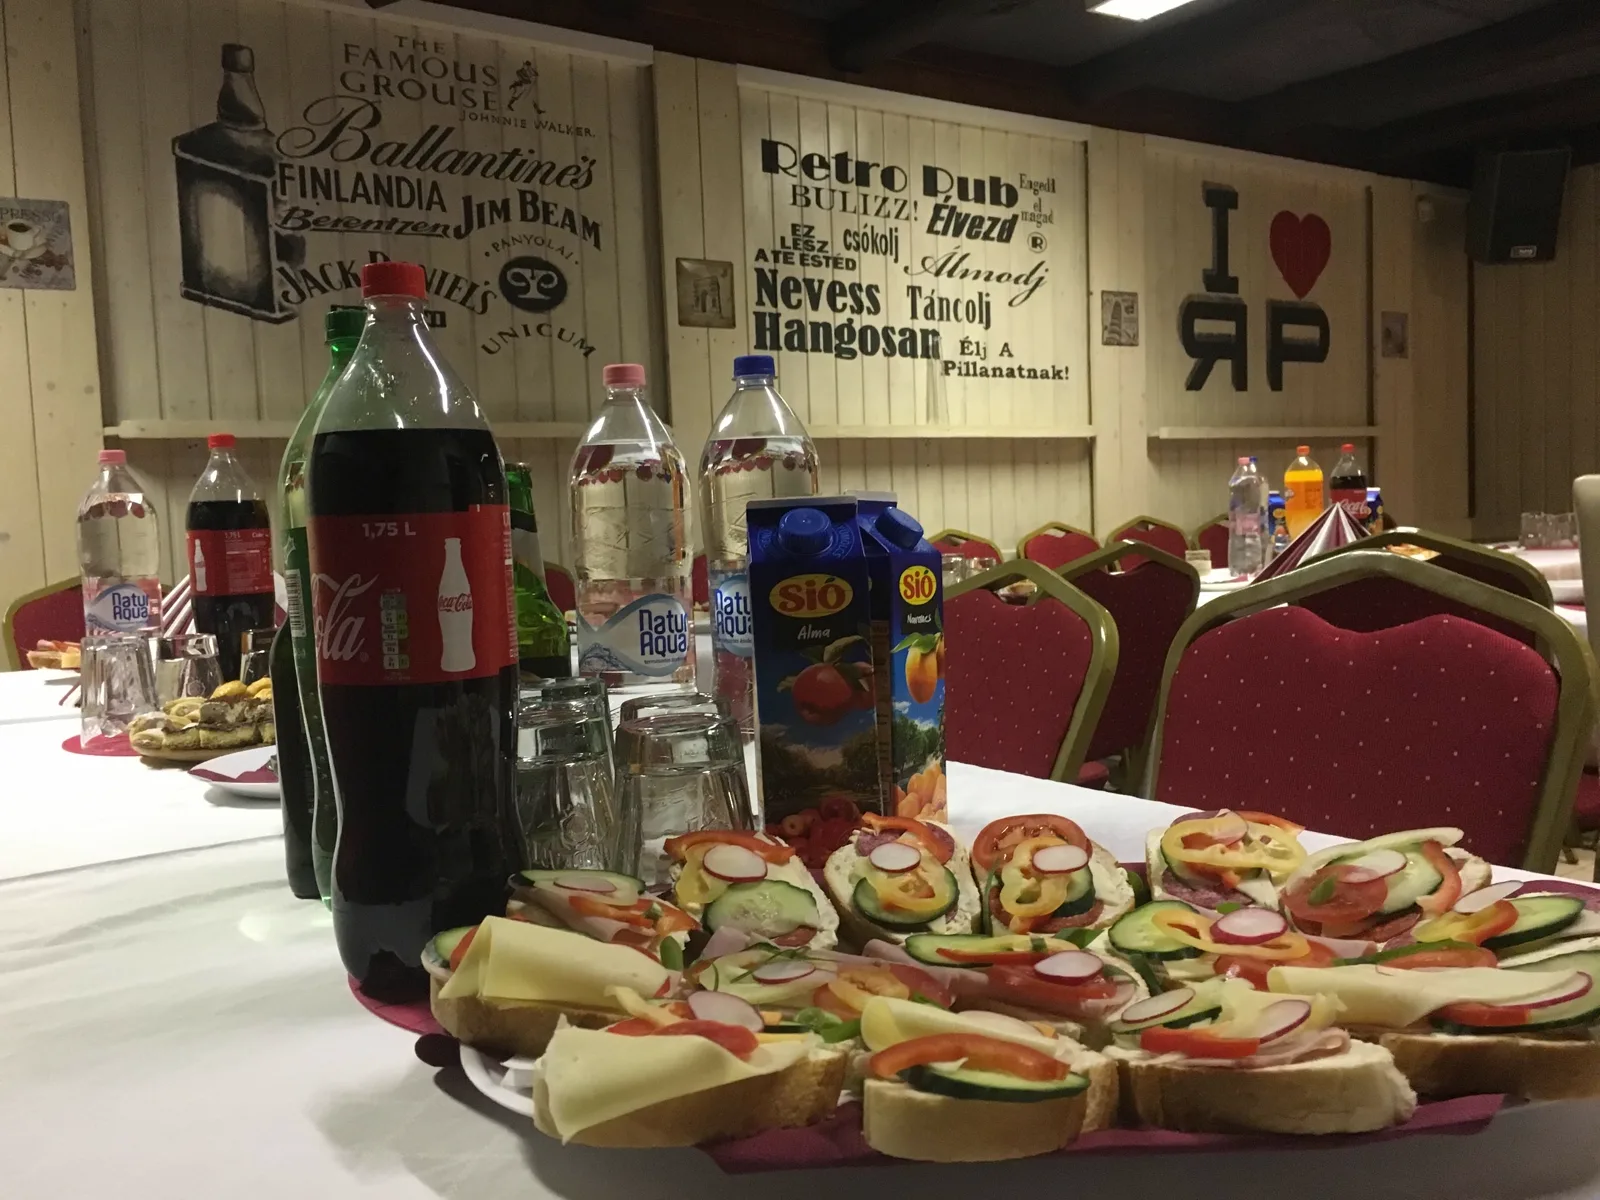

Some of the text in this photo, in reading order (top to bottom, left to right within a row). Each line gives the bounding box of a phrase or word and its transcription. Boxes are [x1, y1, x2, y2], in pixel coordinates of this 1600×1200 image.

[394, 35, 445, 54] THE
[343, 43, 499, 87] FAMOUS
[340, 70, 499, 112] GROUSE
[458, 110, 527, 129] JOHNNIE
[276, 95, 597, 190] Ballantine's
[278, 162, 448, 213] FINLANDIA
[761, 138, 1019, 209] Retro Pub
[453, 189, 602, 252] JIM BEAM
[790, 183, 918, 222] BULIZZ!
[926, 196, 1019, 244] Élvezd
[275, 205, 451, 239] Berentzen
[791, 223, 815, 239] EZ
[491, 234, 574, 260] PANYOLAI
[780, 236, 829, 253] LESZ
[843, 223, 899, 264] csókolj
[276, 260, 362, 305] JACK
[754, 267, 881, 316] Nevess
[903, 245, 1049, 307] Álmodj
[907, 284, 991, 331] Táncolj
[481, 322, 597, 359] UNICUM
[753, 311, 941, 361] Hangosan
[959, 336, 1014, 360] Élj A
[942, 360, 1070, 381] Pillanatnak!
[362, 522, 417, 540] 1,75 L
[113, 606, 148, 621] Aqua
[714, 589, 751, 615] Natu
[640, 631, 687, 657] Aqua
[797, 624, 830, 640] Alma
